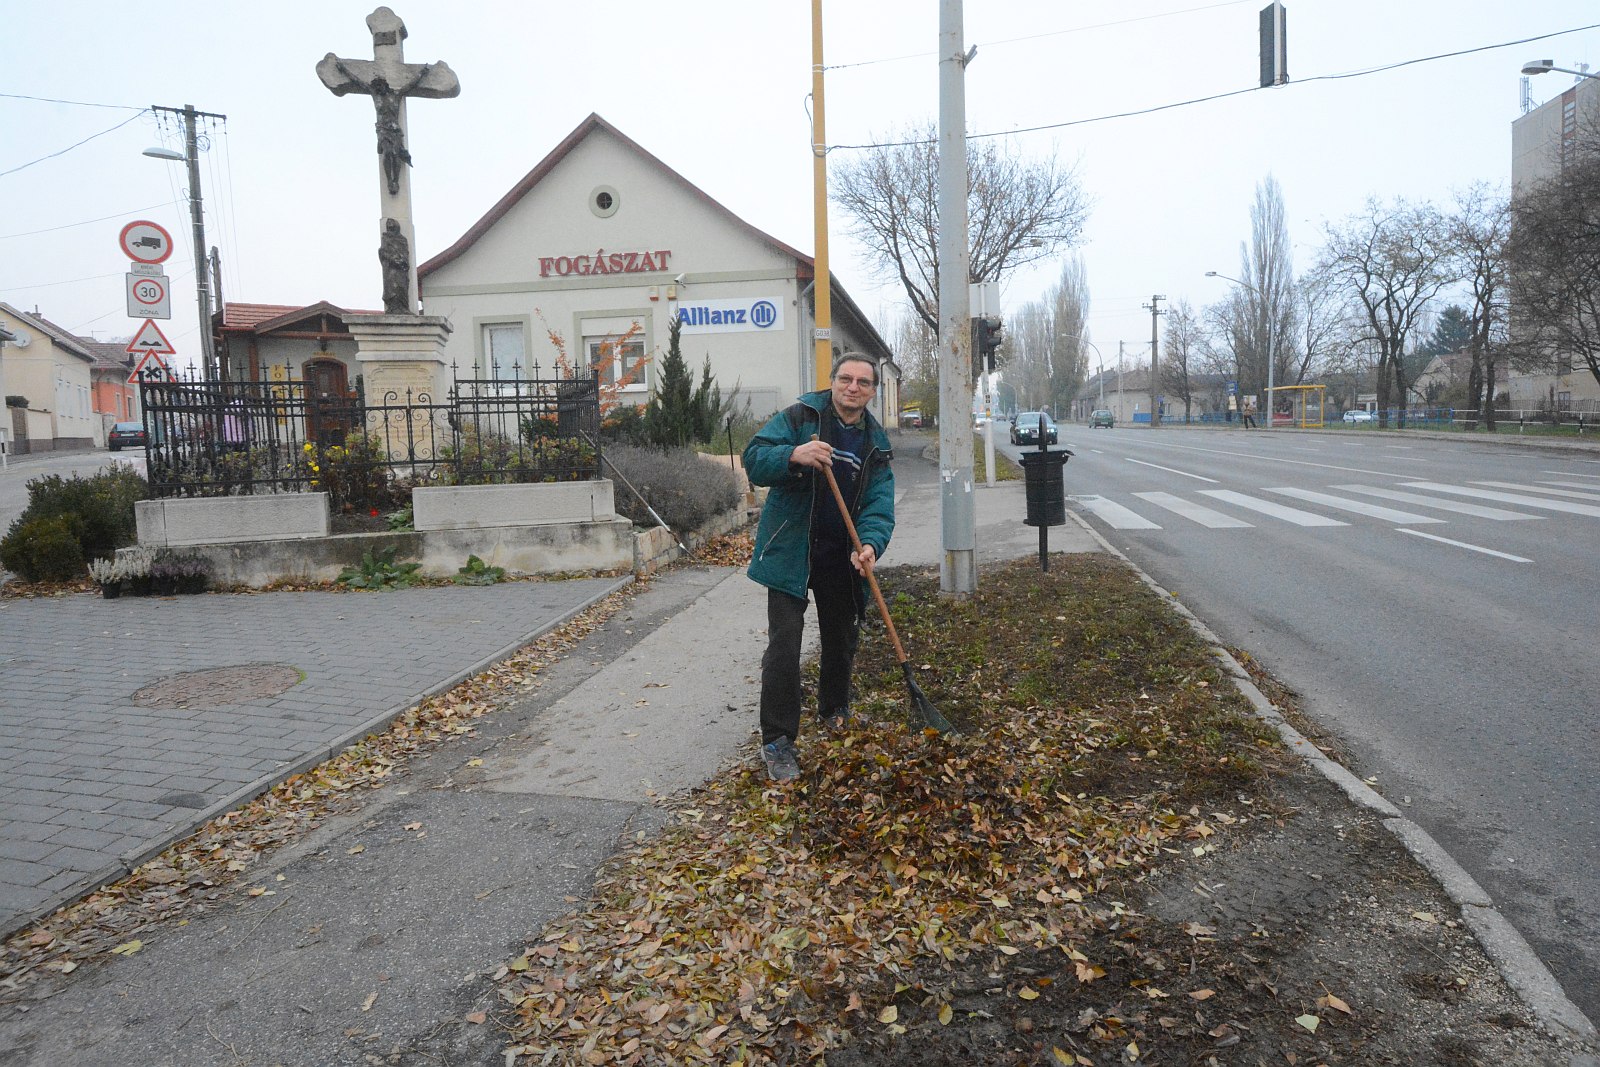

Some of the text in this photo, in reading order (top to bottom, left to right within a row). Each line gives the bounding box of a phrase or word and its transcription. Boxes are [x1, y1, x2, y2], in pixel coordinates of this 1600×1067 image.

[538, 248, 671, 277] FOGÁSZAT
[140, 286, 156, 298] 30
[679, 306, 746, 326] Allianz
